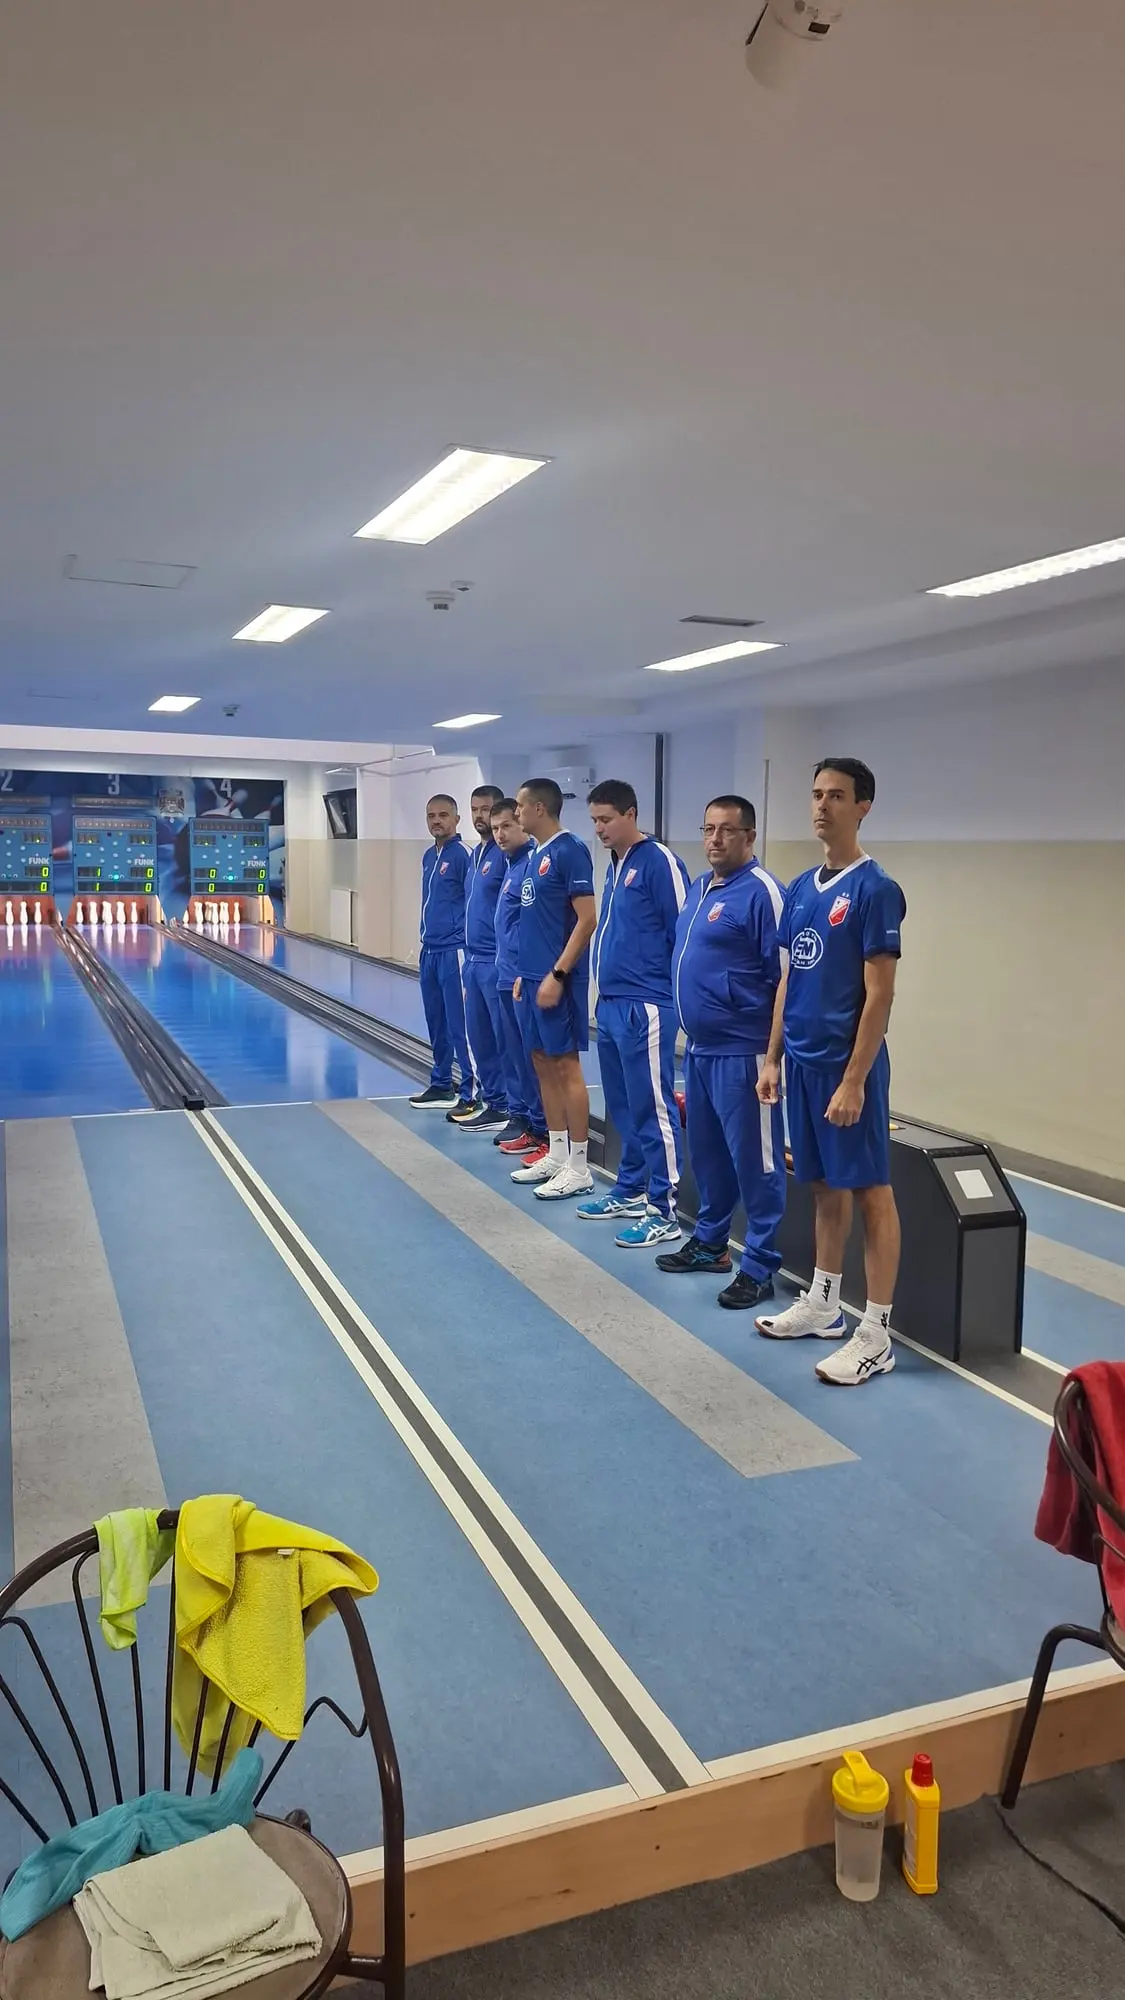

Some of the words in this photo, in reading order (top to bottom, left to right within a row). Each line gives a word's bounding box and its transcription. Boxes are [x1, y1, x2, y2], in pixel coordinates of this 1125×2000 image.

[0, 770, 14, 791] 2
[108, 774, 120, 795] 3
[220, 779, 232, 800] 4
[28, 857, 49, 865] FUNK
[42, 867, 49, 877] 0
[147, 868, 153, 878] 0
[210, 869, 216, 879] 0
[260, 869, 266, 879] 0
[40, 882, 47, 892] 0
[145, 883, 152, 892] 0
[209, 883, 215, 892] 0
[258, 884, 264, 893] 0
